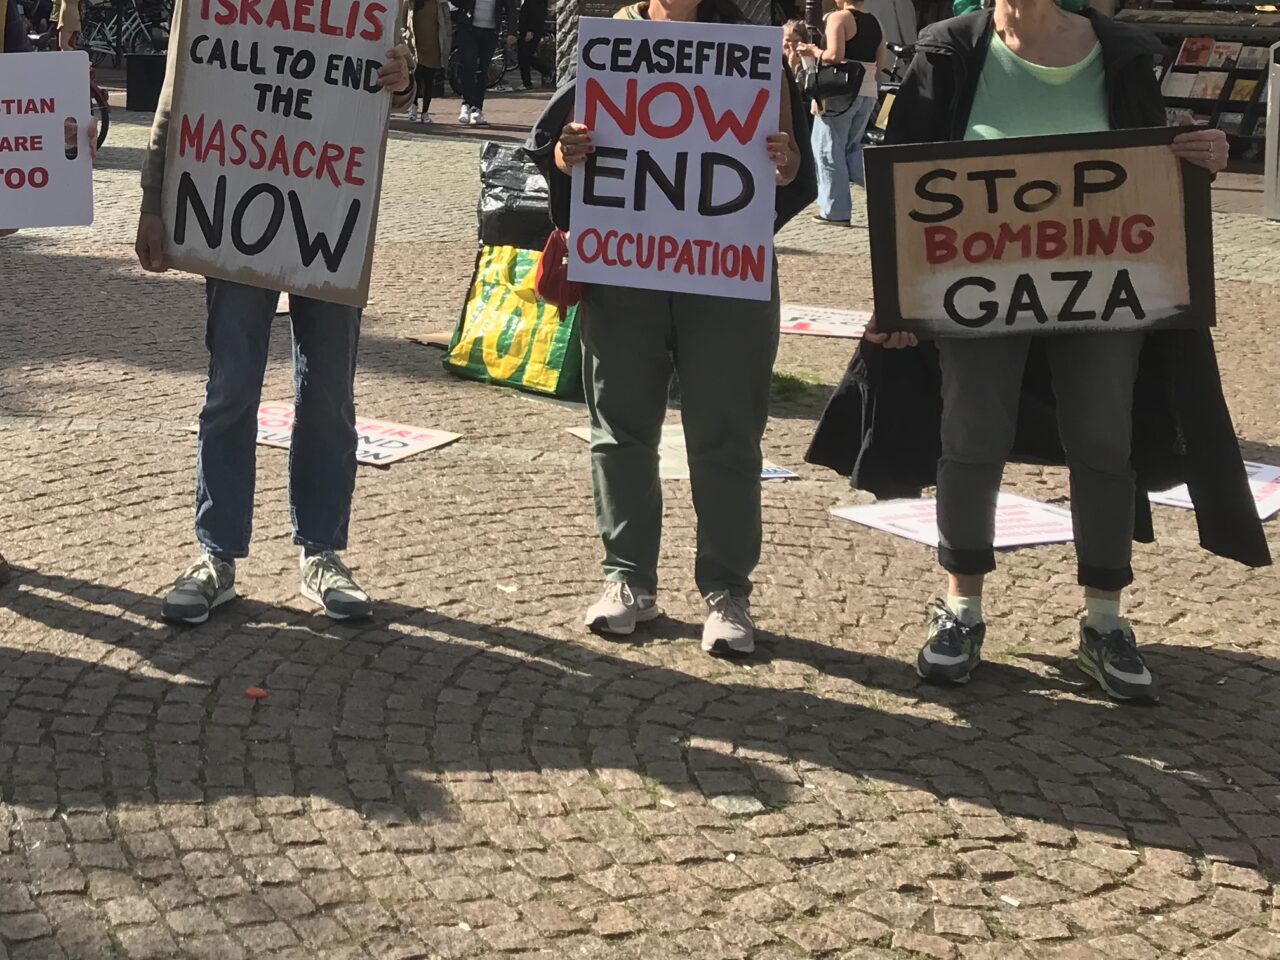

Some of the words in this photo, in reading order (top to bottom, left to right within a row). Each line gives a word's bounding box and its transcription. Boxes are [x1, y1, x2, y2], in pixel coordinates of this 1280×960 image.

[190, 34, 266, 75] CALL
[273, 45, 317, 80] TO
[324, 53, 385, 94] END
[582, 37, 772, 81] CEASEFIRE
[253, 83, 313, 120] THE
[584, 77, 771, 145] NOW
[178, 113, 366, 189] MASSACRE
[582, 146, 756, 217] END
[173, 171, 362, 273] NOW
[576, 227, 766, 283] OCCUPATION
[943, 268, 1146, 328] GAZA
